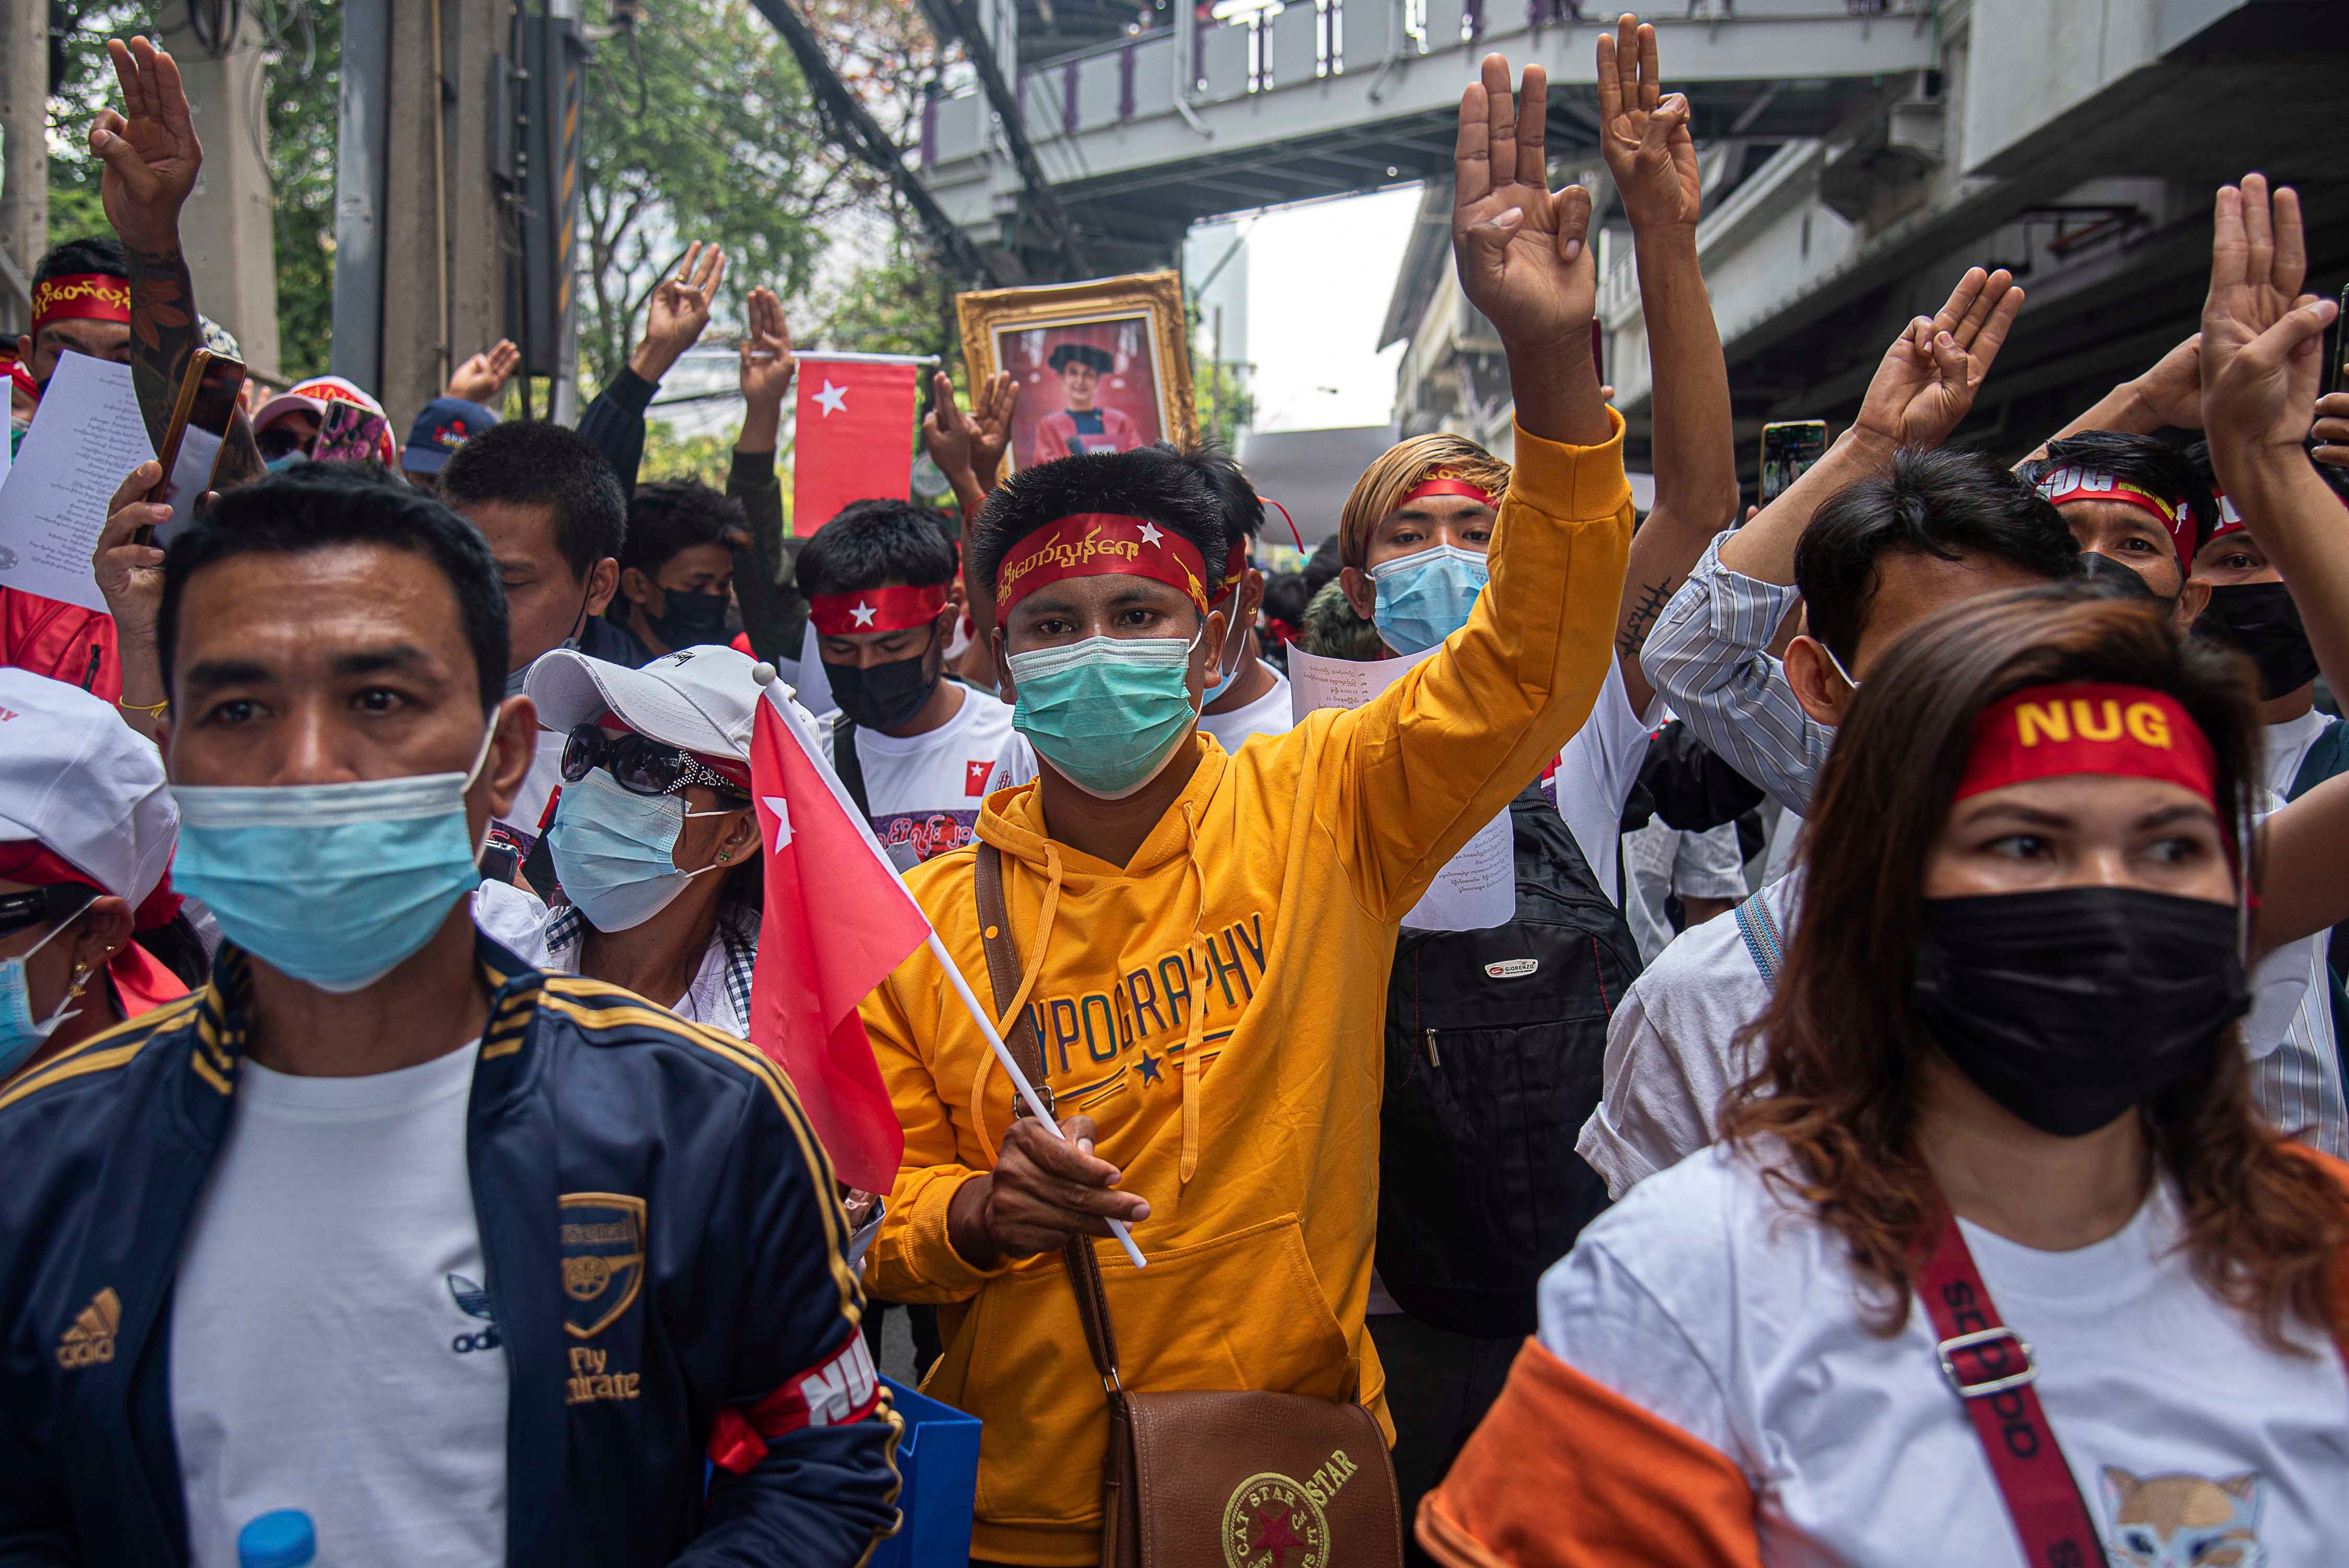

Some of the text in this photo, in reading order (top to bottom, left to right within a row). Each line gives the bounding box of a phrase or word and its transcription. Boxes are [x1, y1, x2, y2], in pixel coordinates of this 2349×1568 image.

[2015, 698, 2172, 749] NUG
[1028, 913, 1266, 1076] YPOGRAPHY
[568, 1347, 607, 1374] Fly
[800, 1324, 879, 1426] NU
[1306, 1450, 1358, 1507] STAR
[1235, 1486, 1296, 1557] CAT STAR
